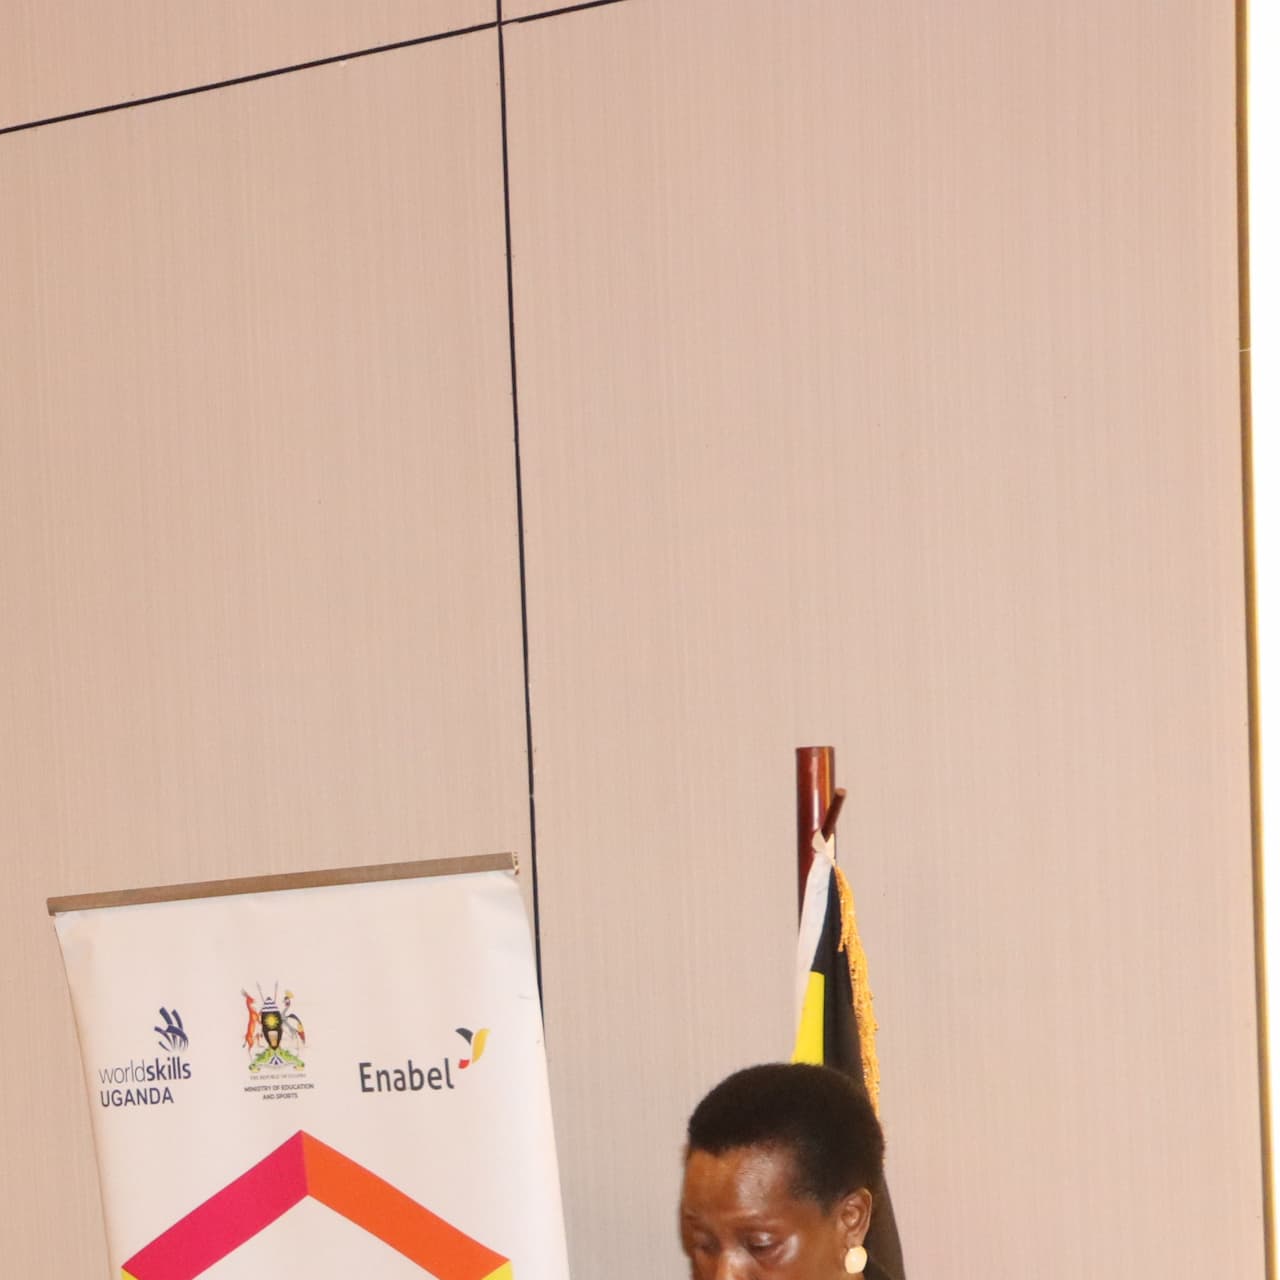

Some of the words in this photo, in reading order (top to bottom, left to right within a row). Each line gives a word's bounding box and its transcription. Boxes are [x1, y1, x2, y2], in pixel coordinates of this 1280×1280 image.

[99, 1056, 191, 1085] worldskills
[359, 1058, 454, 1093] Enabel
[100, 1088, 174, 1108] UGANDA
